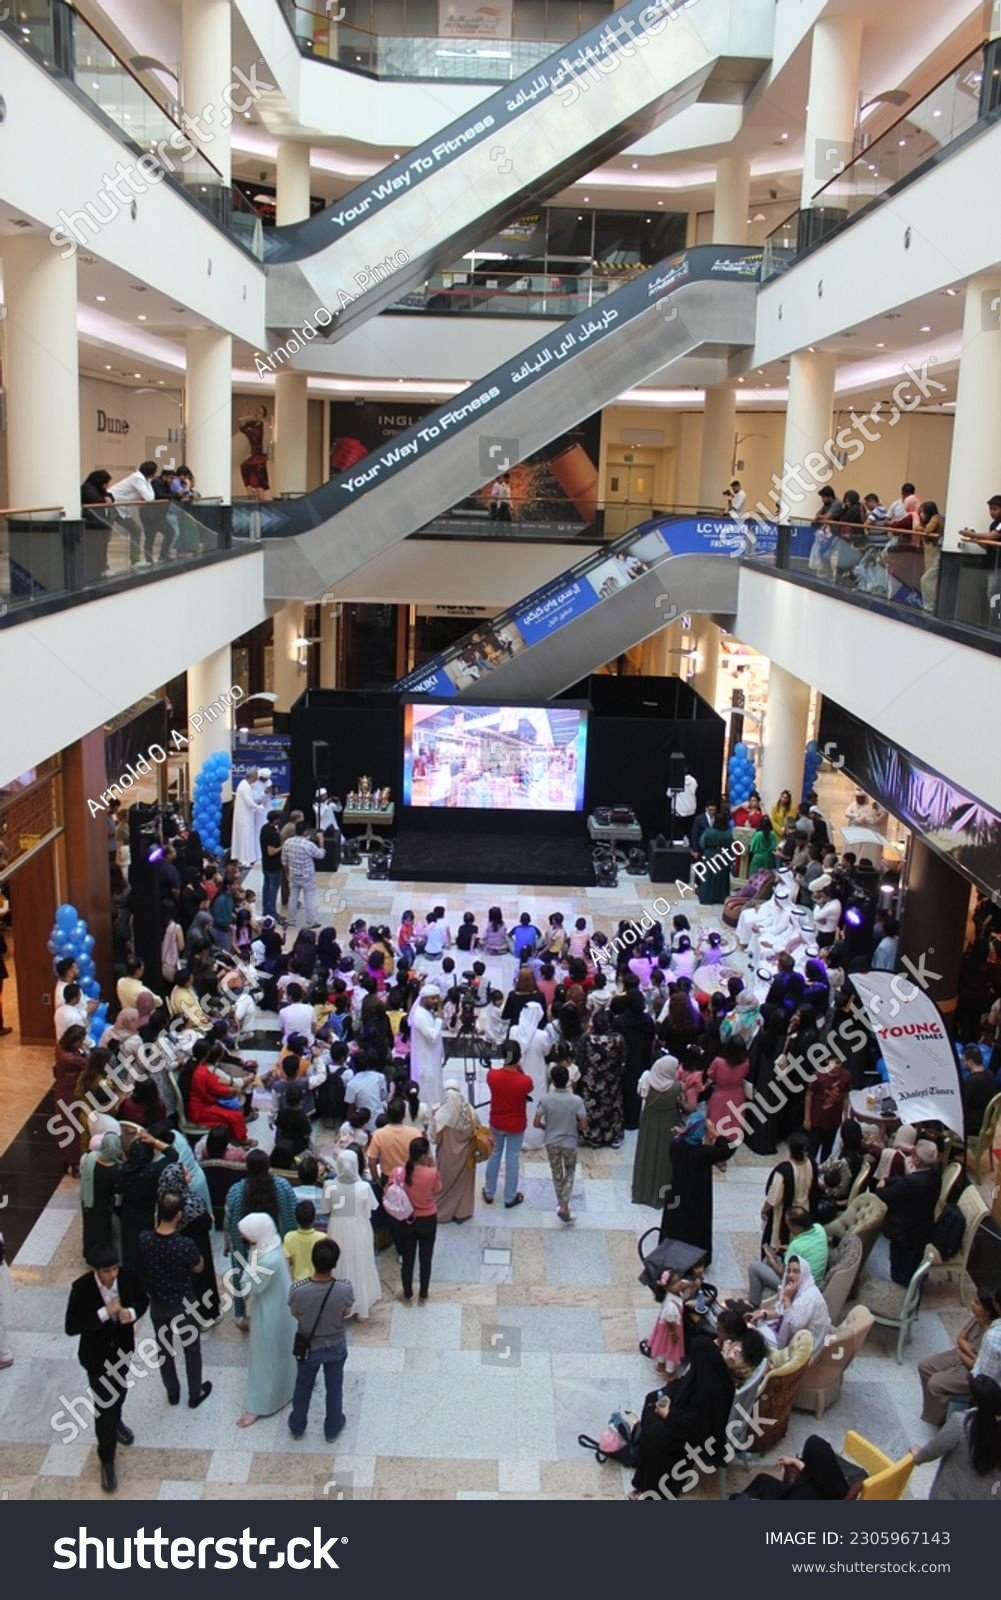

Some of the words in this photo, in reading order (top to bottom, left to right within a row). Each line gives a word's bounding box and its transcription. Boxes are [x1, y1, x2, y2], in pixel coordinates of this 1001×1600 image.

[331, 197, 372, 227] Your
[371, 170, 411, 200] Way
[410, 156, 433, 173] To
[431, 114, 495, 161] Fitness
[510, 348, 553, 383] اللياقة
[97, 409, 129, 435] Dune
[378, 415, 415, 426] INGL
[341, 465, 381, 493] Your
[380, 439, 419, 467] Way
[417, 425, 441, 442] To
[439, 386, 501, 430] Fitness
[697, 523, 712, 534] LC
[878, 1022, 941, 1040] YOUNG
[914, 1033, 944, 1041] TIMES
[929, 1086, 954, 1096] Times
